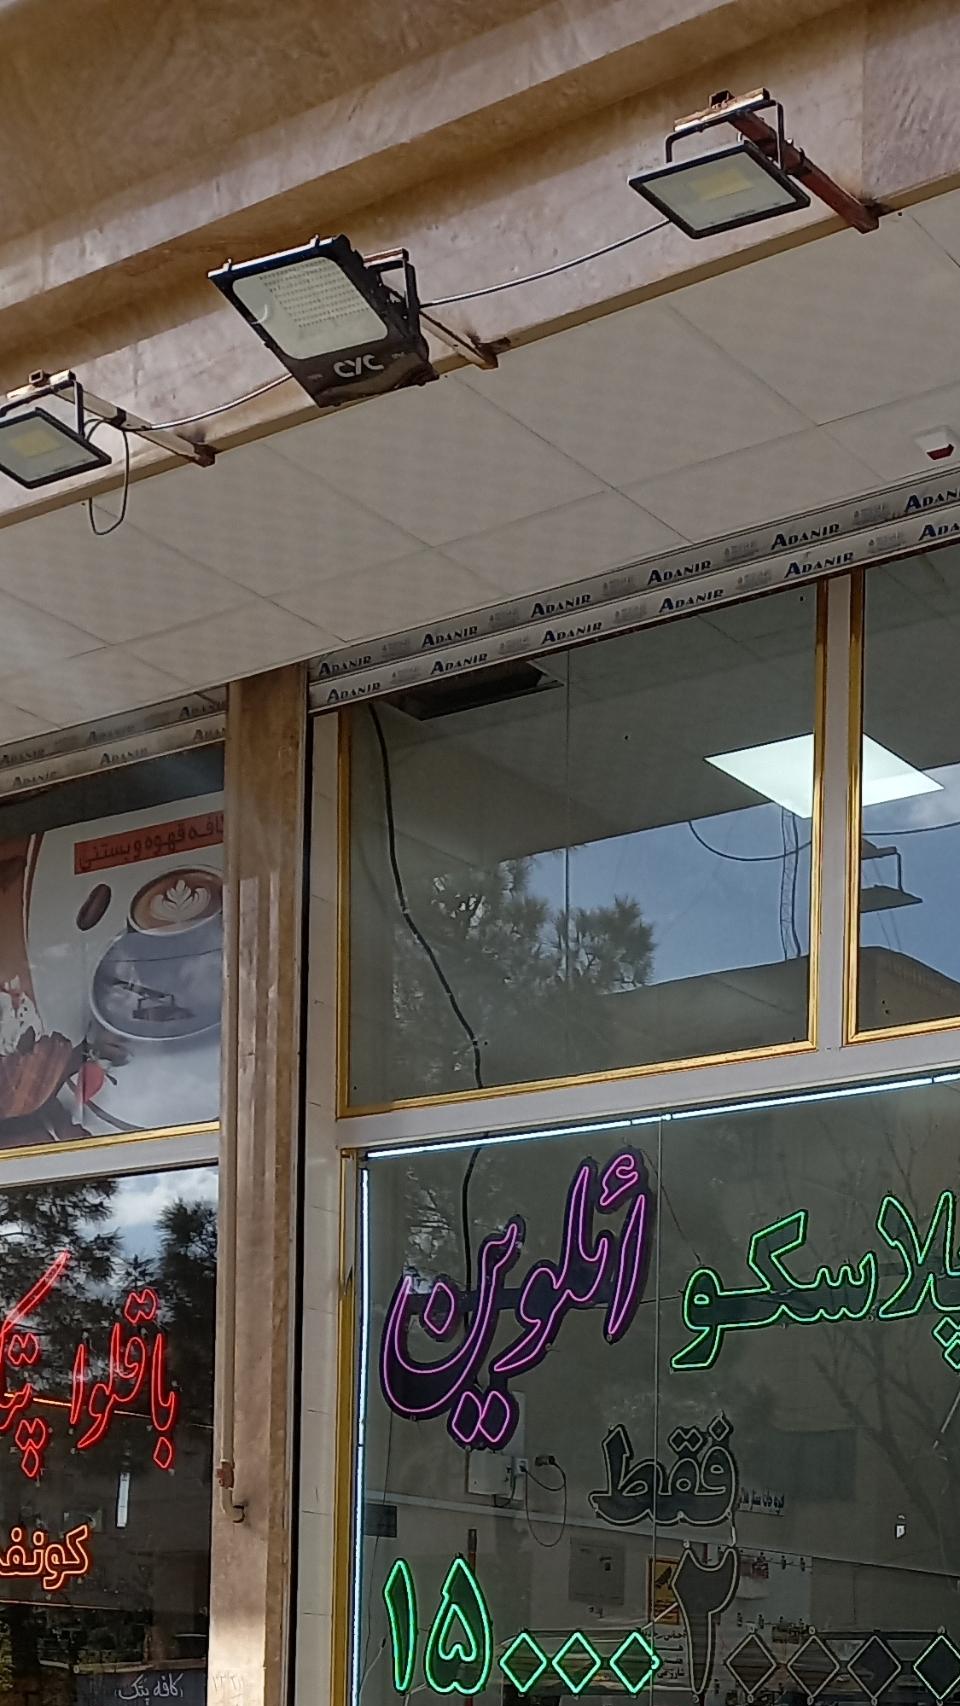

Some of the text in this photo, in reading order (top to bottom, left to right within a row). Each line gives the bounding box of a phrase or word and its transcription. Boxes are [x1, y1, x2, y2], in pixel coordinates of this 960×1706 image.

[333, 354, 384, 378] CYC
[421, 625, 478, 648] ADANIR
[530, 594, 591, 618] ADANIR
[647, 560, 712, 585] ADANIR
[771, 523, 840, 550] ADANIR
[430, 653, 488, 675] ADANIR
[540, 622, 602, 645] ADANIR
[658, 589, 724, 613] ADANIR
[784, 552, 854, 579] ADANIR
[69, 1287, 176, 1469] باقلوا
[589, 1413, 738, 1526] فقط
